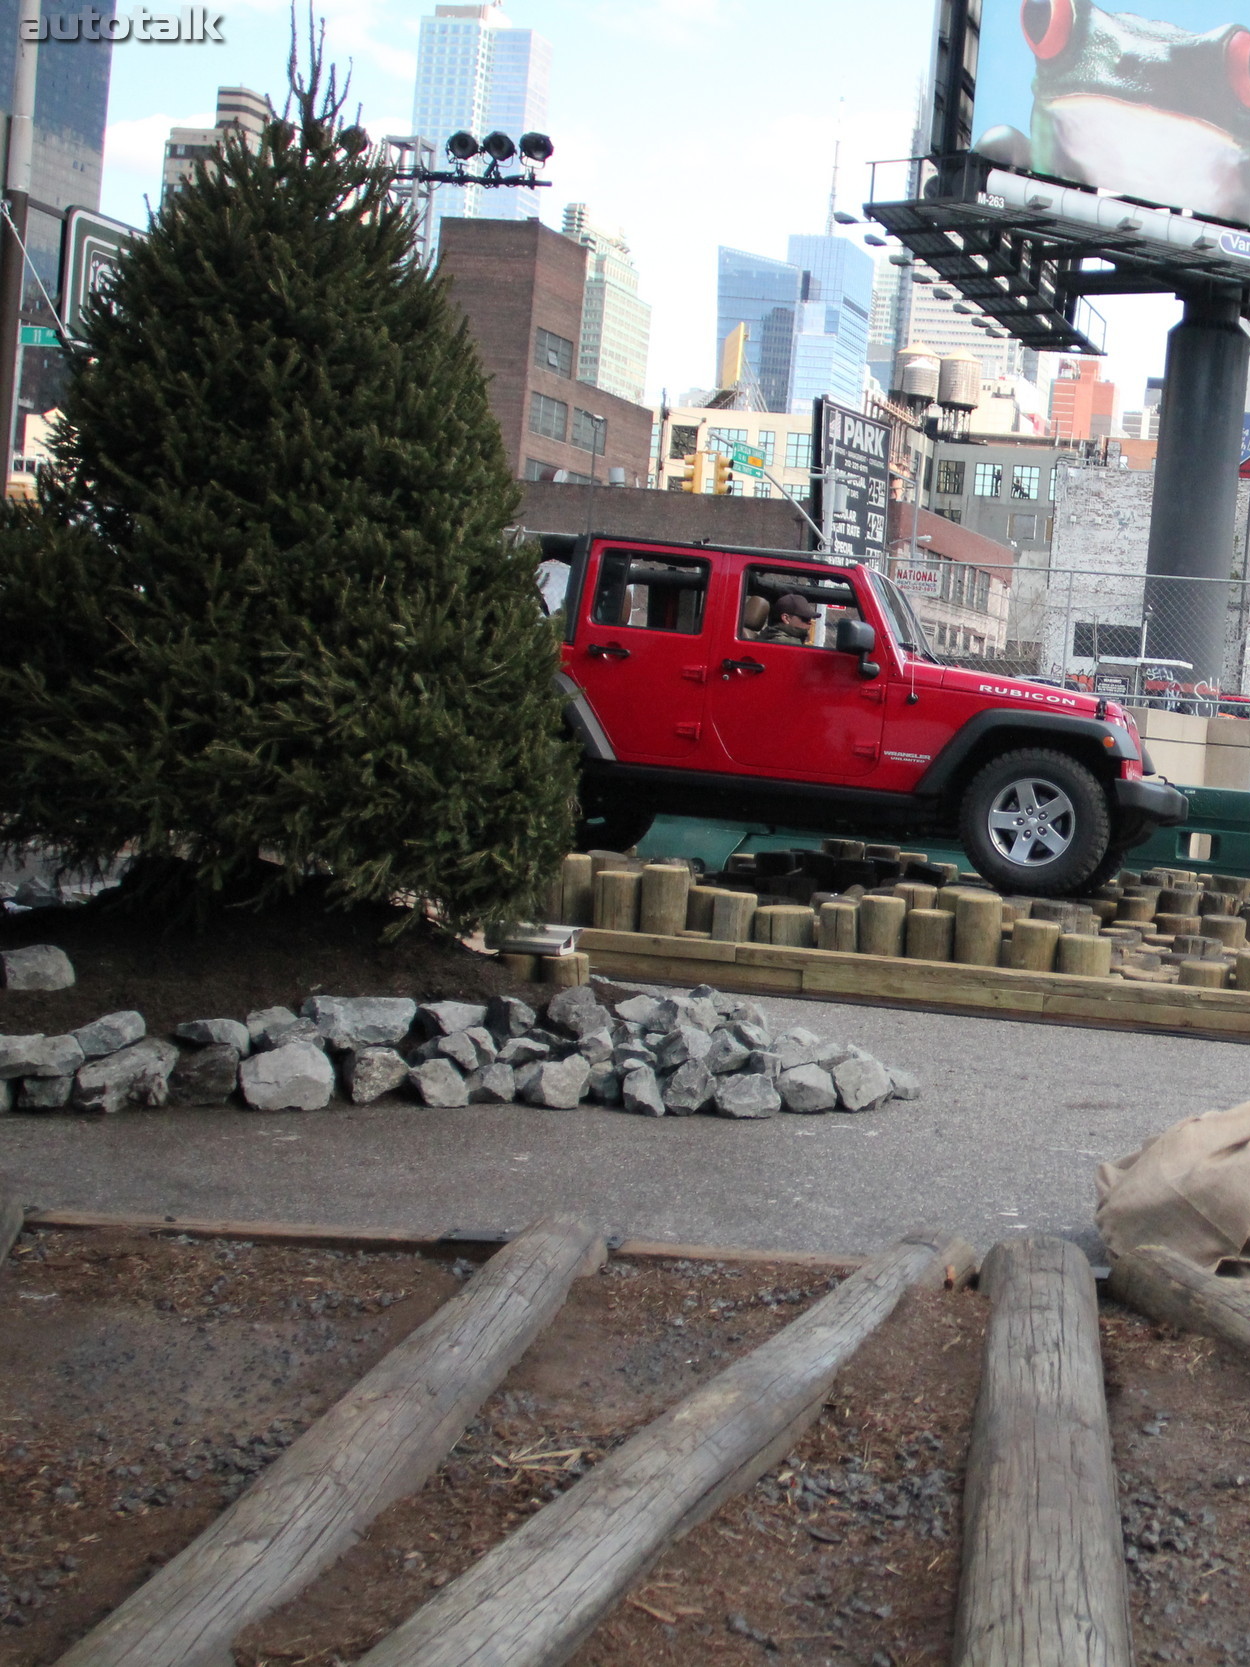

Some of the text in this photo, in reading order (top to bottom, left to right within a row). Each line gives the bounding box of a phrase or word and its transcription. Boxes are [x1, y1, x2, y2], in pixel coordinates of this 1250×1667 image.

[843, 416, 886, 459] PARK
[846, 523, 860, 538] RATE
[896, 568, 937, 583] NATIONAL
[979, 685, 1076, 706] RUBICON
[883, 750, 931, 760] WRANGLER
